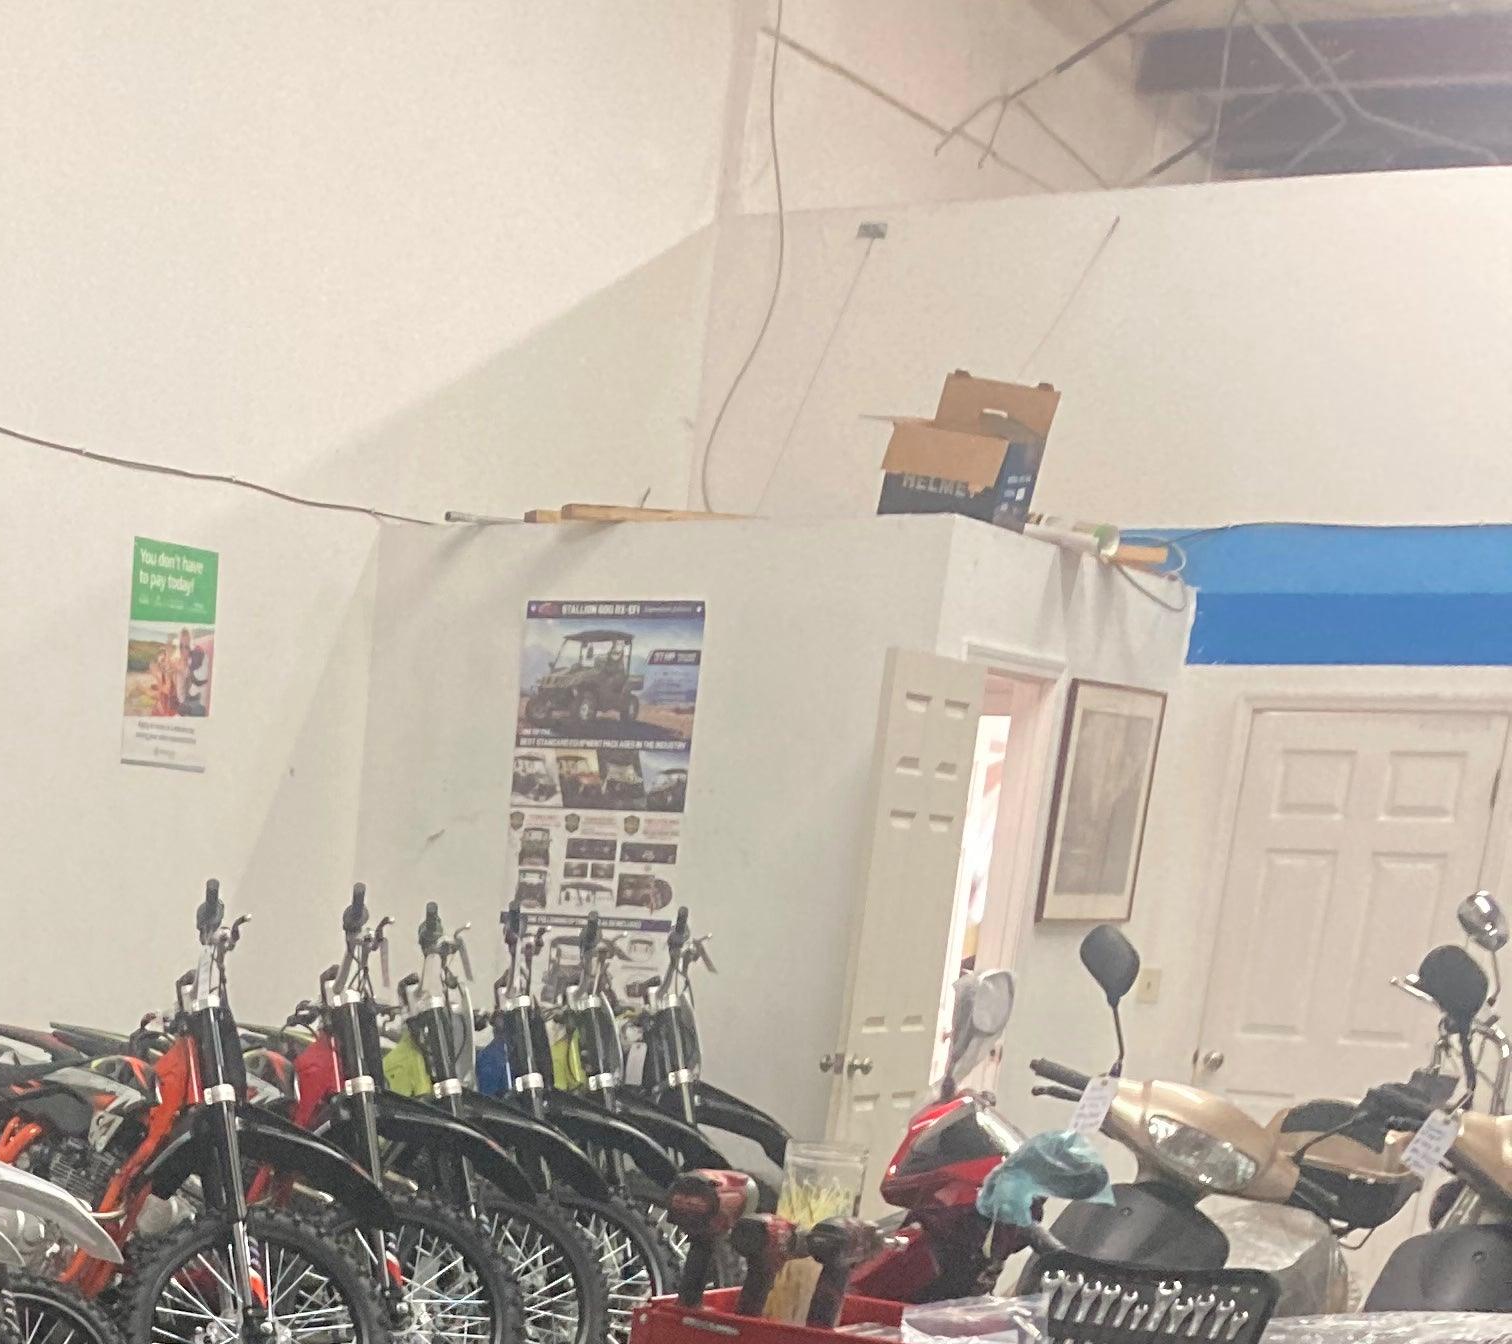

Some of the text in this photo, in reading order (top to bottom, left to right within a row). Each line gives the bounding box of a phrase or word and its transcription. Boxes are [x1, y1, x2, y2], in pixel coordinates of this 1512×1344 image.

[902, 473, 974, 499] HELME
[140, 547, 204, 575] You don't have
[139, 569, 195, 596] to pay today!
